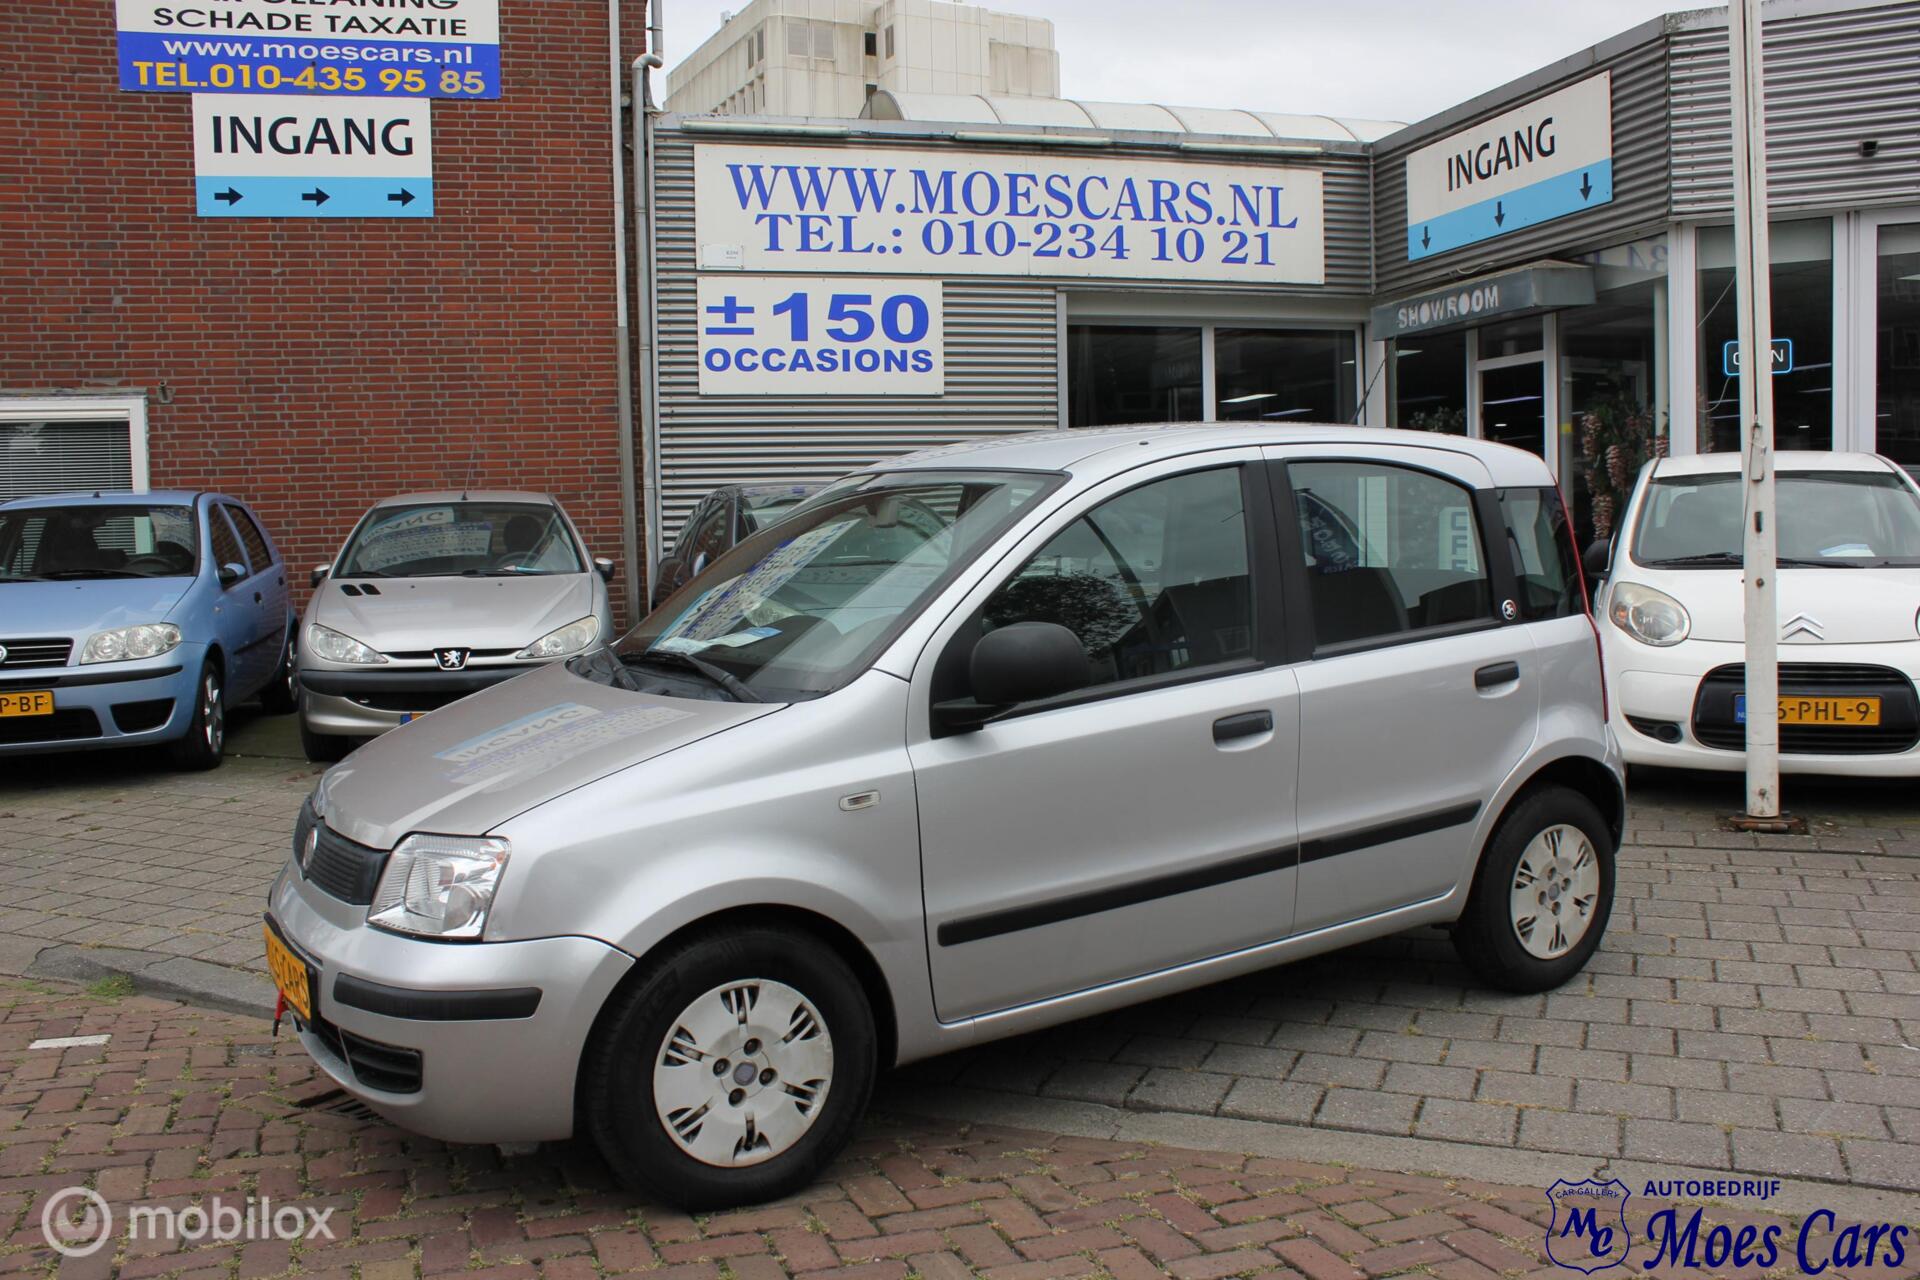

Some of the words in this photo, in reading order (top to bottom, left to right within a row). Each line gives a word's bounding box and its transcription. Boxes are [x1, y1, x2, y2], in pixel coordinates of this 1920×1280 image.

[153, 8, 312, 32] SCHADE
[325, 15, 466, 36] TAXATIE
[162, 39, 473, 64] www.moescars.nl
[132, 61, 366, 91] TEL.010-435
[378, 69, 426, 93] 95
[439, 71, 485, 95] 85
[213, 116, 414, 156] INGANG
[1447, 116, 1556, 193] INGANG
[726, 164, 1298, 230] WWW.MOESCARS.NL
[754, 212, 904, 255] TEL.:
[920, 218, 1131, 261] 010-234
[1152, 226, 1205, 264] 10
[1221, 229, 1277, 267] 21
[1397, 284, 1500, 329] SHOWROOM
[704, 348, 933, 374] OCCASIONS
[1777, 701, 1870, 721] 6-PHL-9
